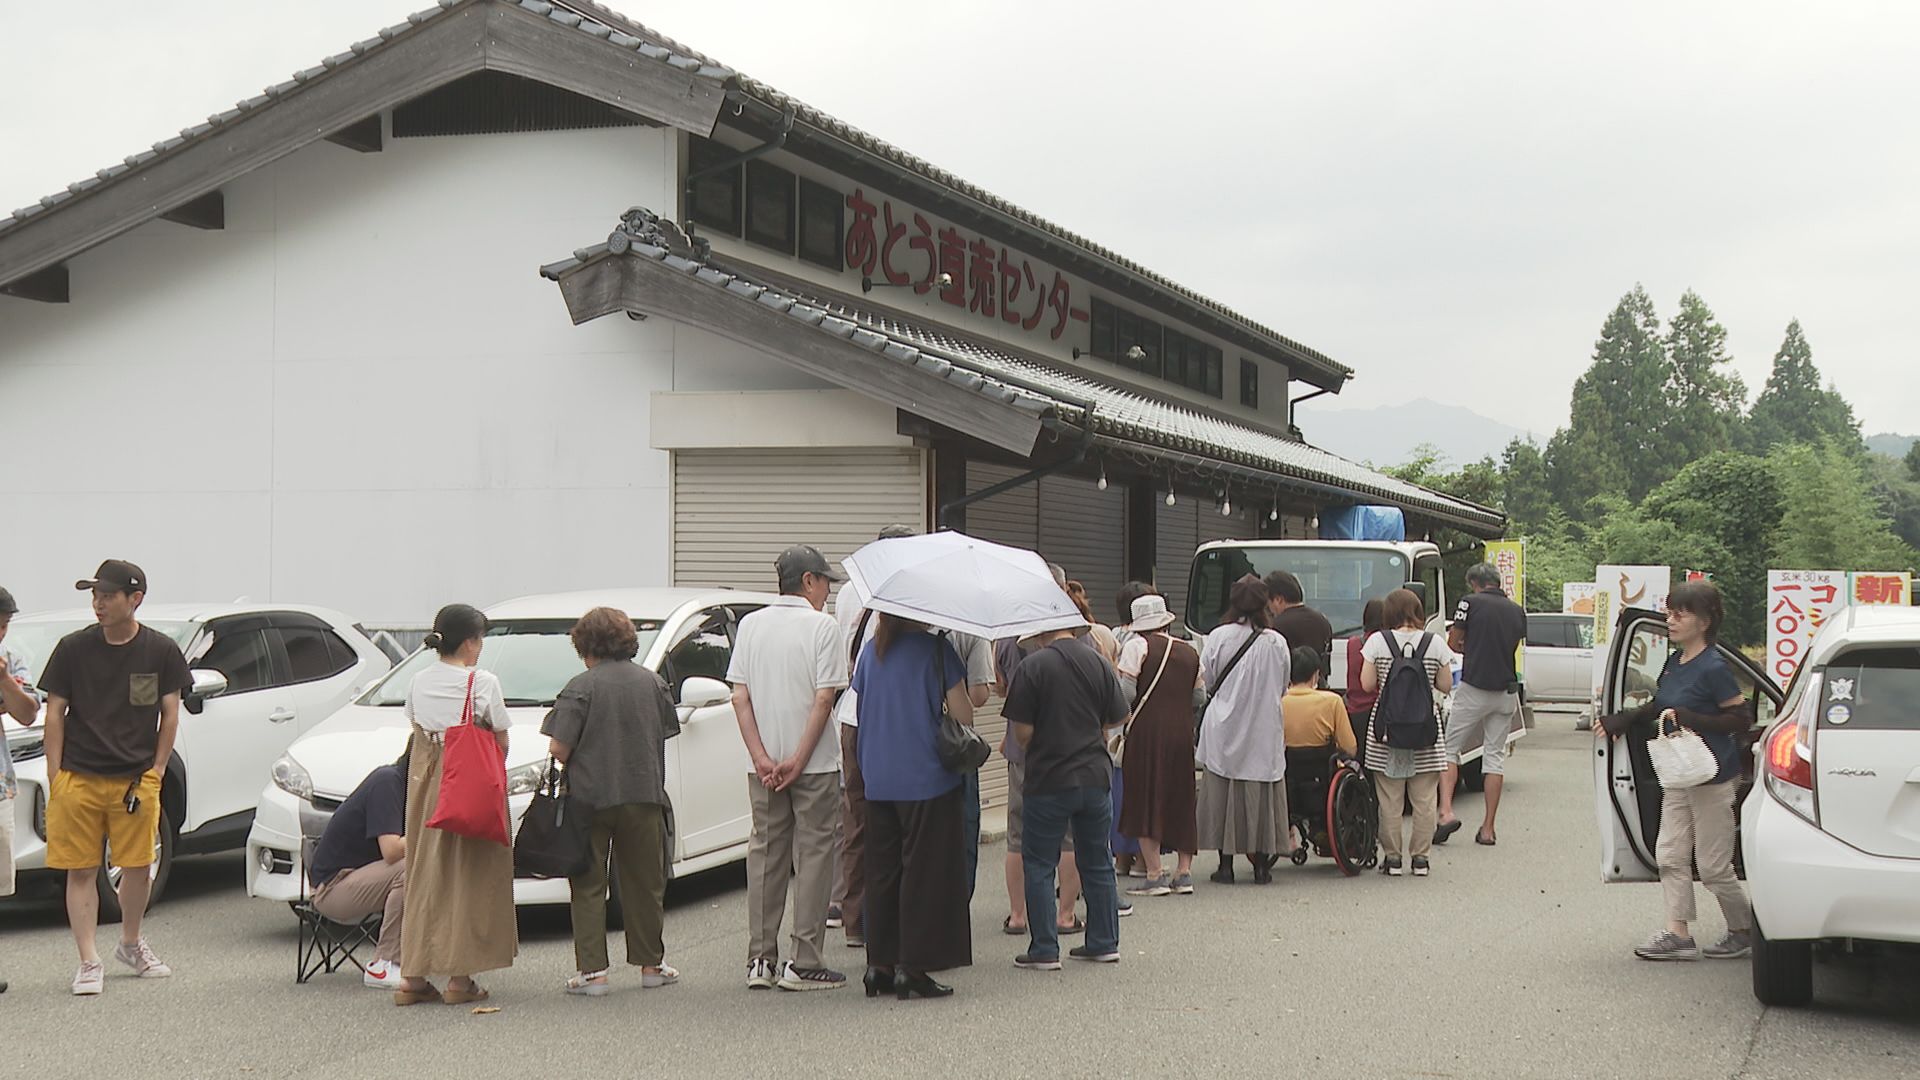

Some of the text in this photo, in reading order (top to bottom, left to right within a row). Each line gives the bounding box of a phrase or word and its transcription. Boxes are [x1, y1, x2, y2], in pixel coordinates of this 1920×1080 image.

[846, 189, 1089, 340] あとう直売センター
[1856, 575, 1903, 604] 新
